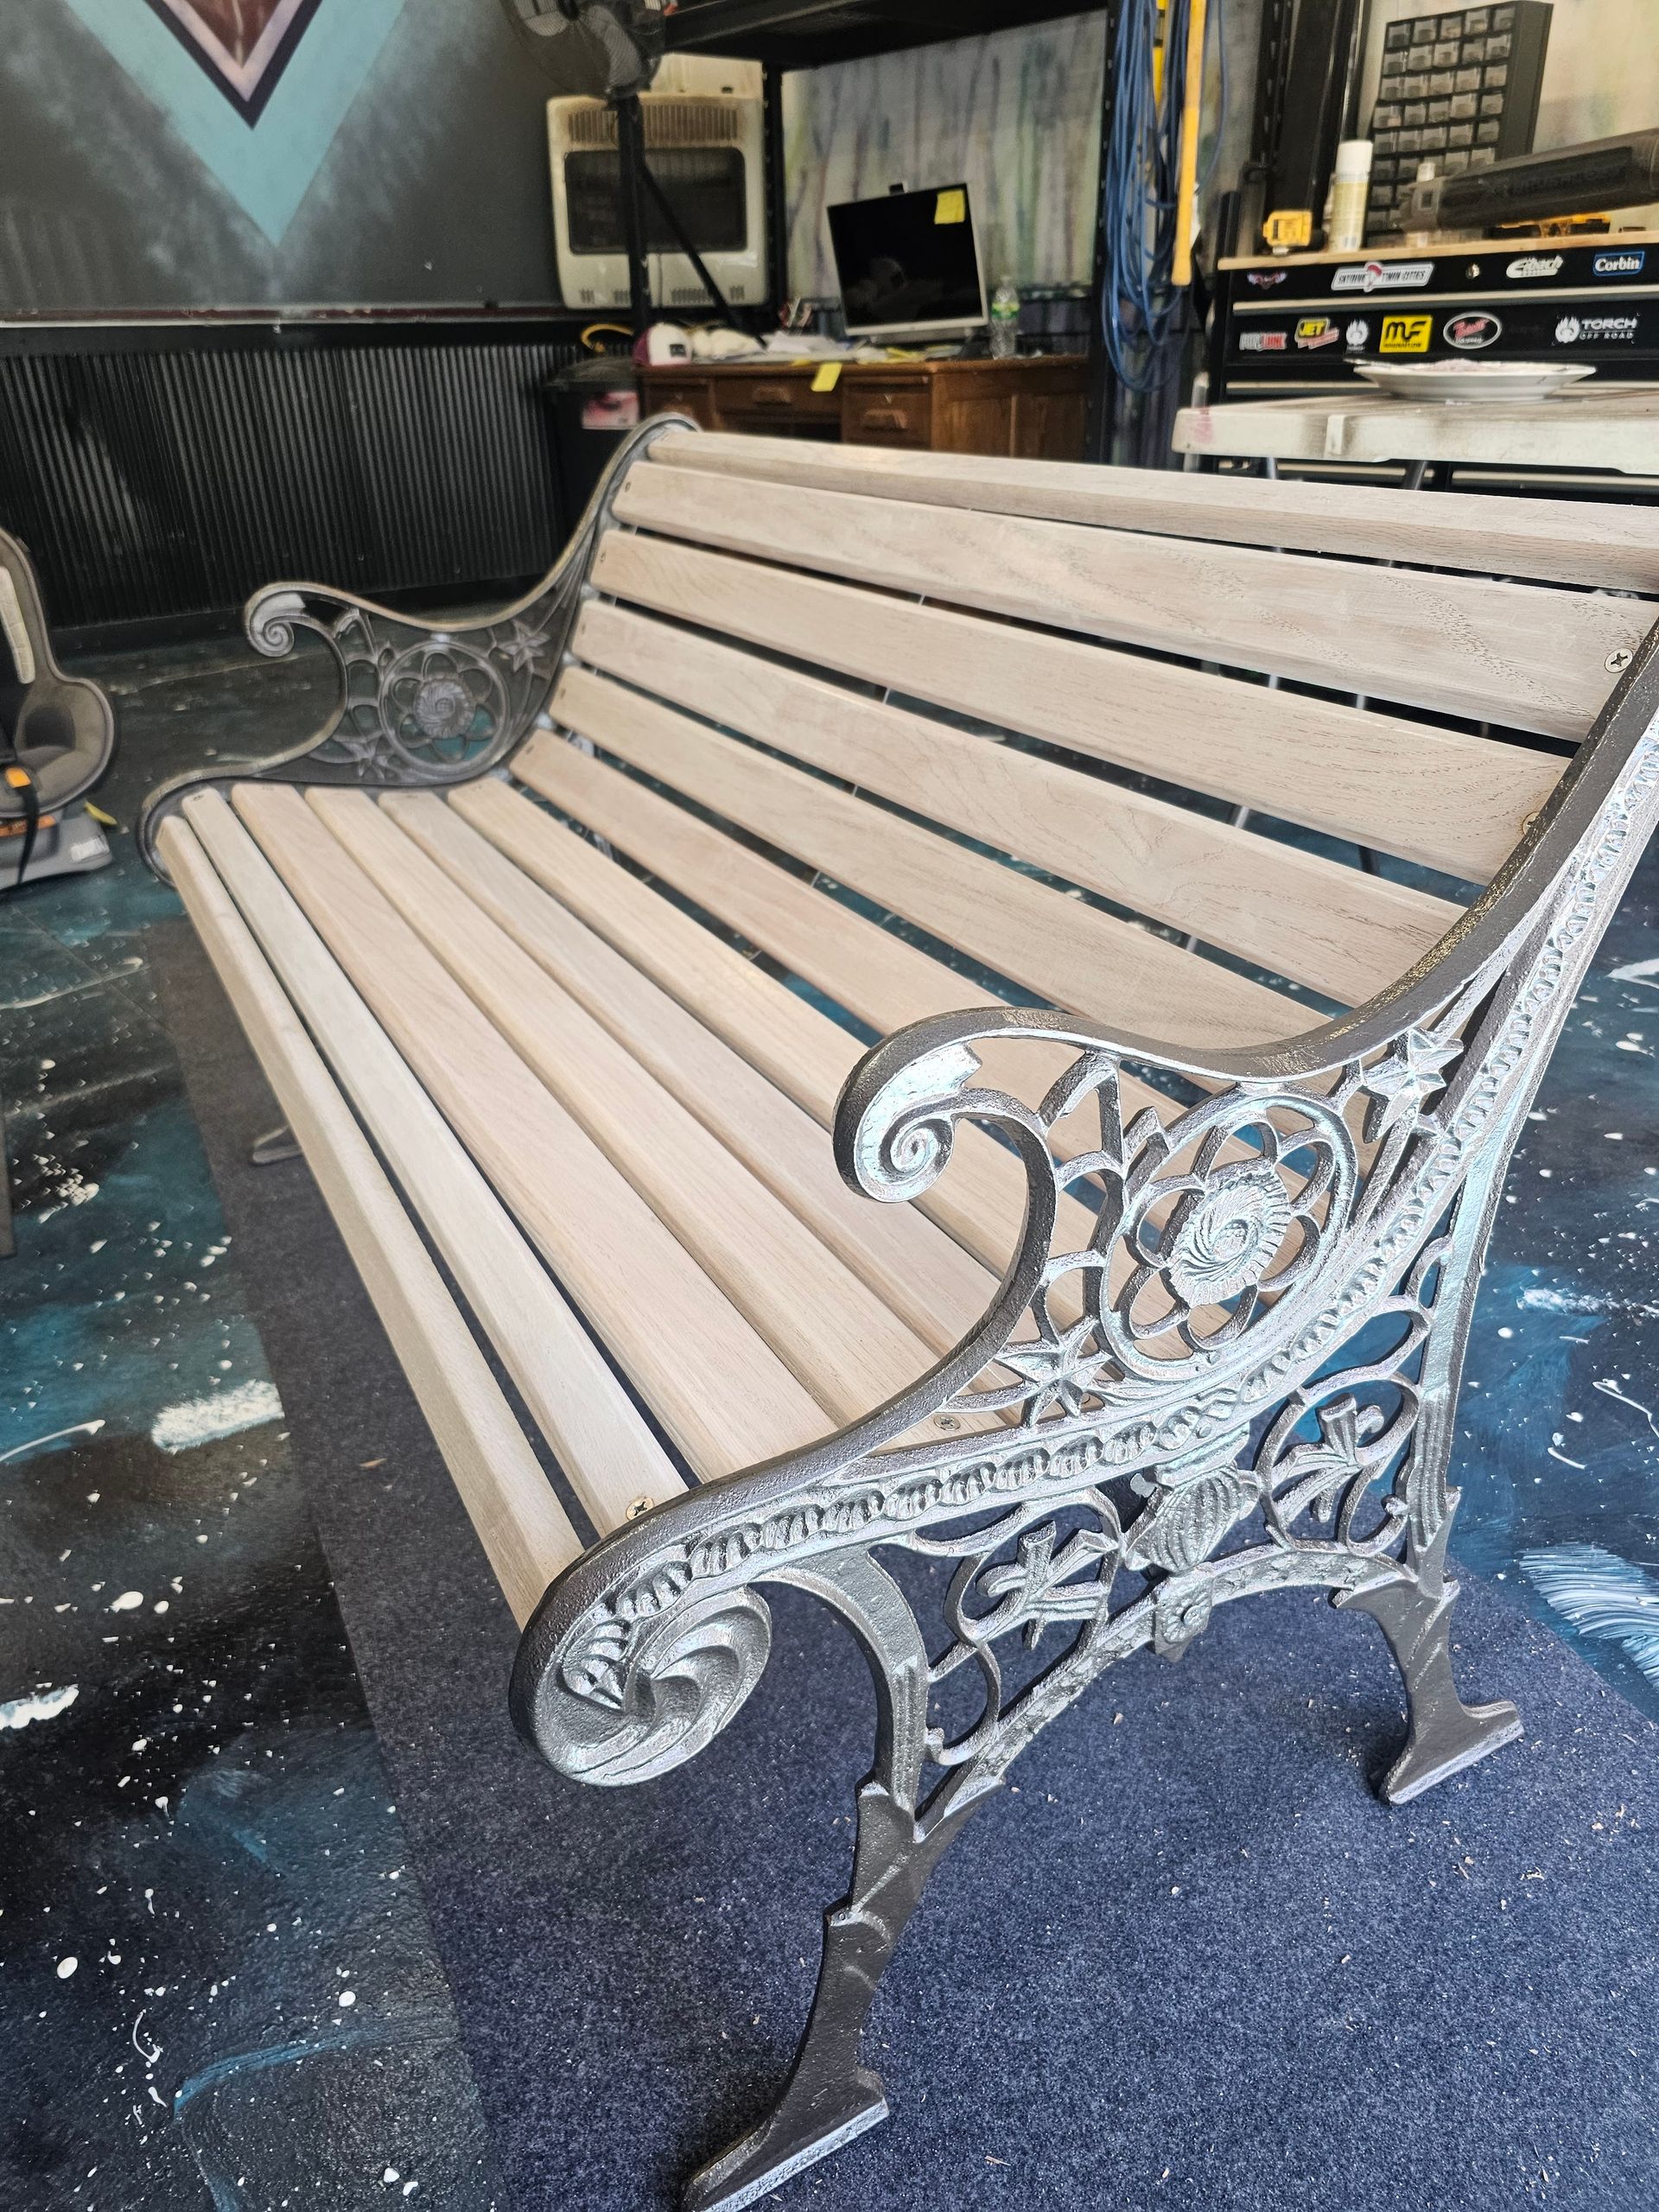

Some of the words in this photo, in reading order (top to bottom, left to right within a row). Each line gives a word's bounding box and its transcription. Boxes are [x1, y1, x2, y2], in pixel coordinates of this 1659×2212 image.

[1594, 256, 1640, 272] Corbin
[1299, 321, 1325, 337] JET
[1581, 318, 1638, 330] TORCH
[1580, 332, 1599, 340] OFF
[1604, 331, 1634, 340] ROAD
